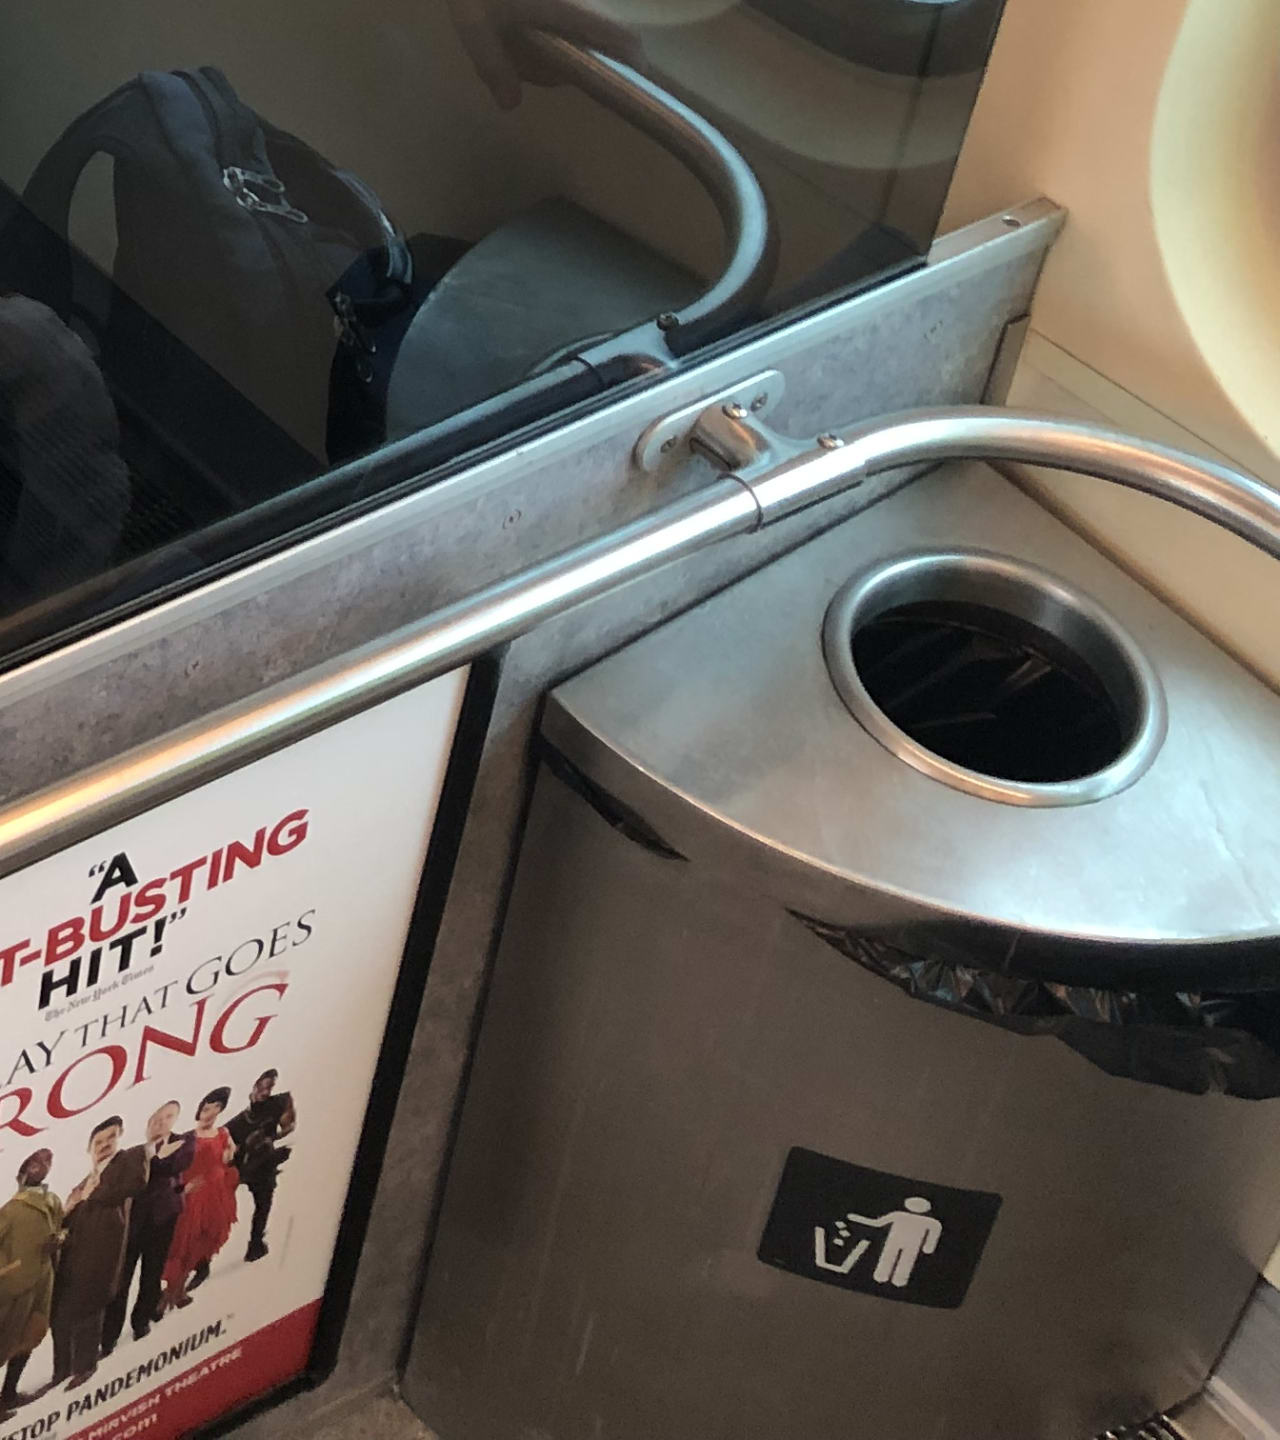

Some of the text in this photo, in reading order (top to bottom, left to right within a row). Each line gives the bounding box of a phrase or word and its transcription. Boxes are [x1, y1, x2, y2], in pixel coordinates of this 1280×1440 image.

[74, 980, 178, 1050] THAT
[185, 908, 317, 996] GOES
[1, 1320, 227, 1440] STOP PANDEMONIUM.
[165, 1346, 242, 1397] THEATRE
